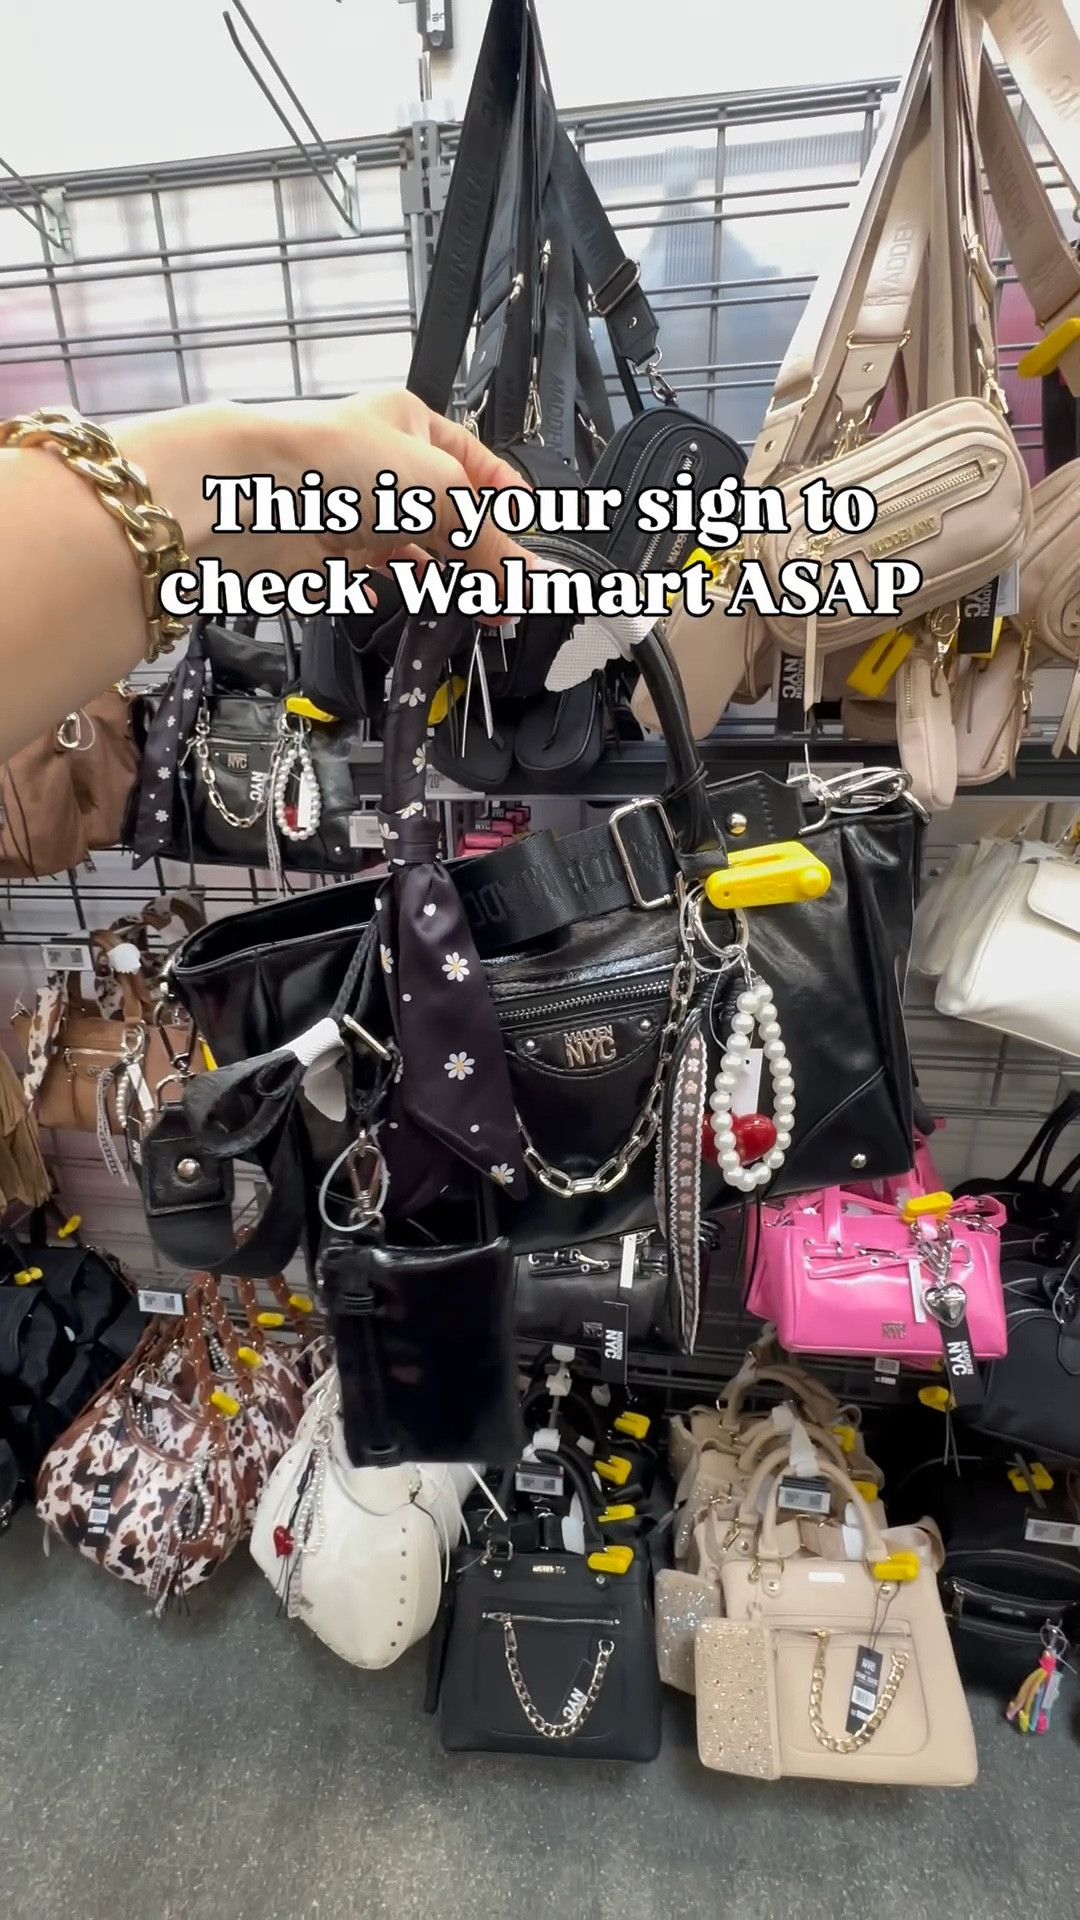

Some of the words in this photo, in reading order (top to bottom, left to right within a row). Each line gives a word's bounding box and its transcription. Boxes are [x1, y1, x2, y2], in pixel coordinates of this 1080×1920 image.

[781, 658, 799, 698] NYC
[250, 771, 264, 801] NYC
[563, 1025, 613, 1046] MADDEN
[565, 1036, 617, 1068] NYC
[604, 1329, 617, 1358] NYC
[947, 1341, 968, 1376] NYC
[562, 1687, 588, 1720] NYC
